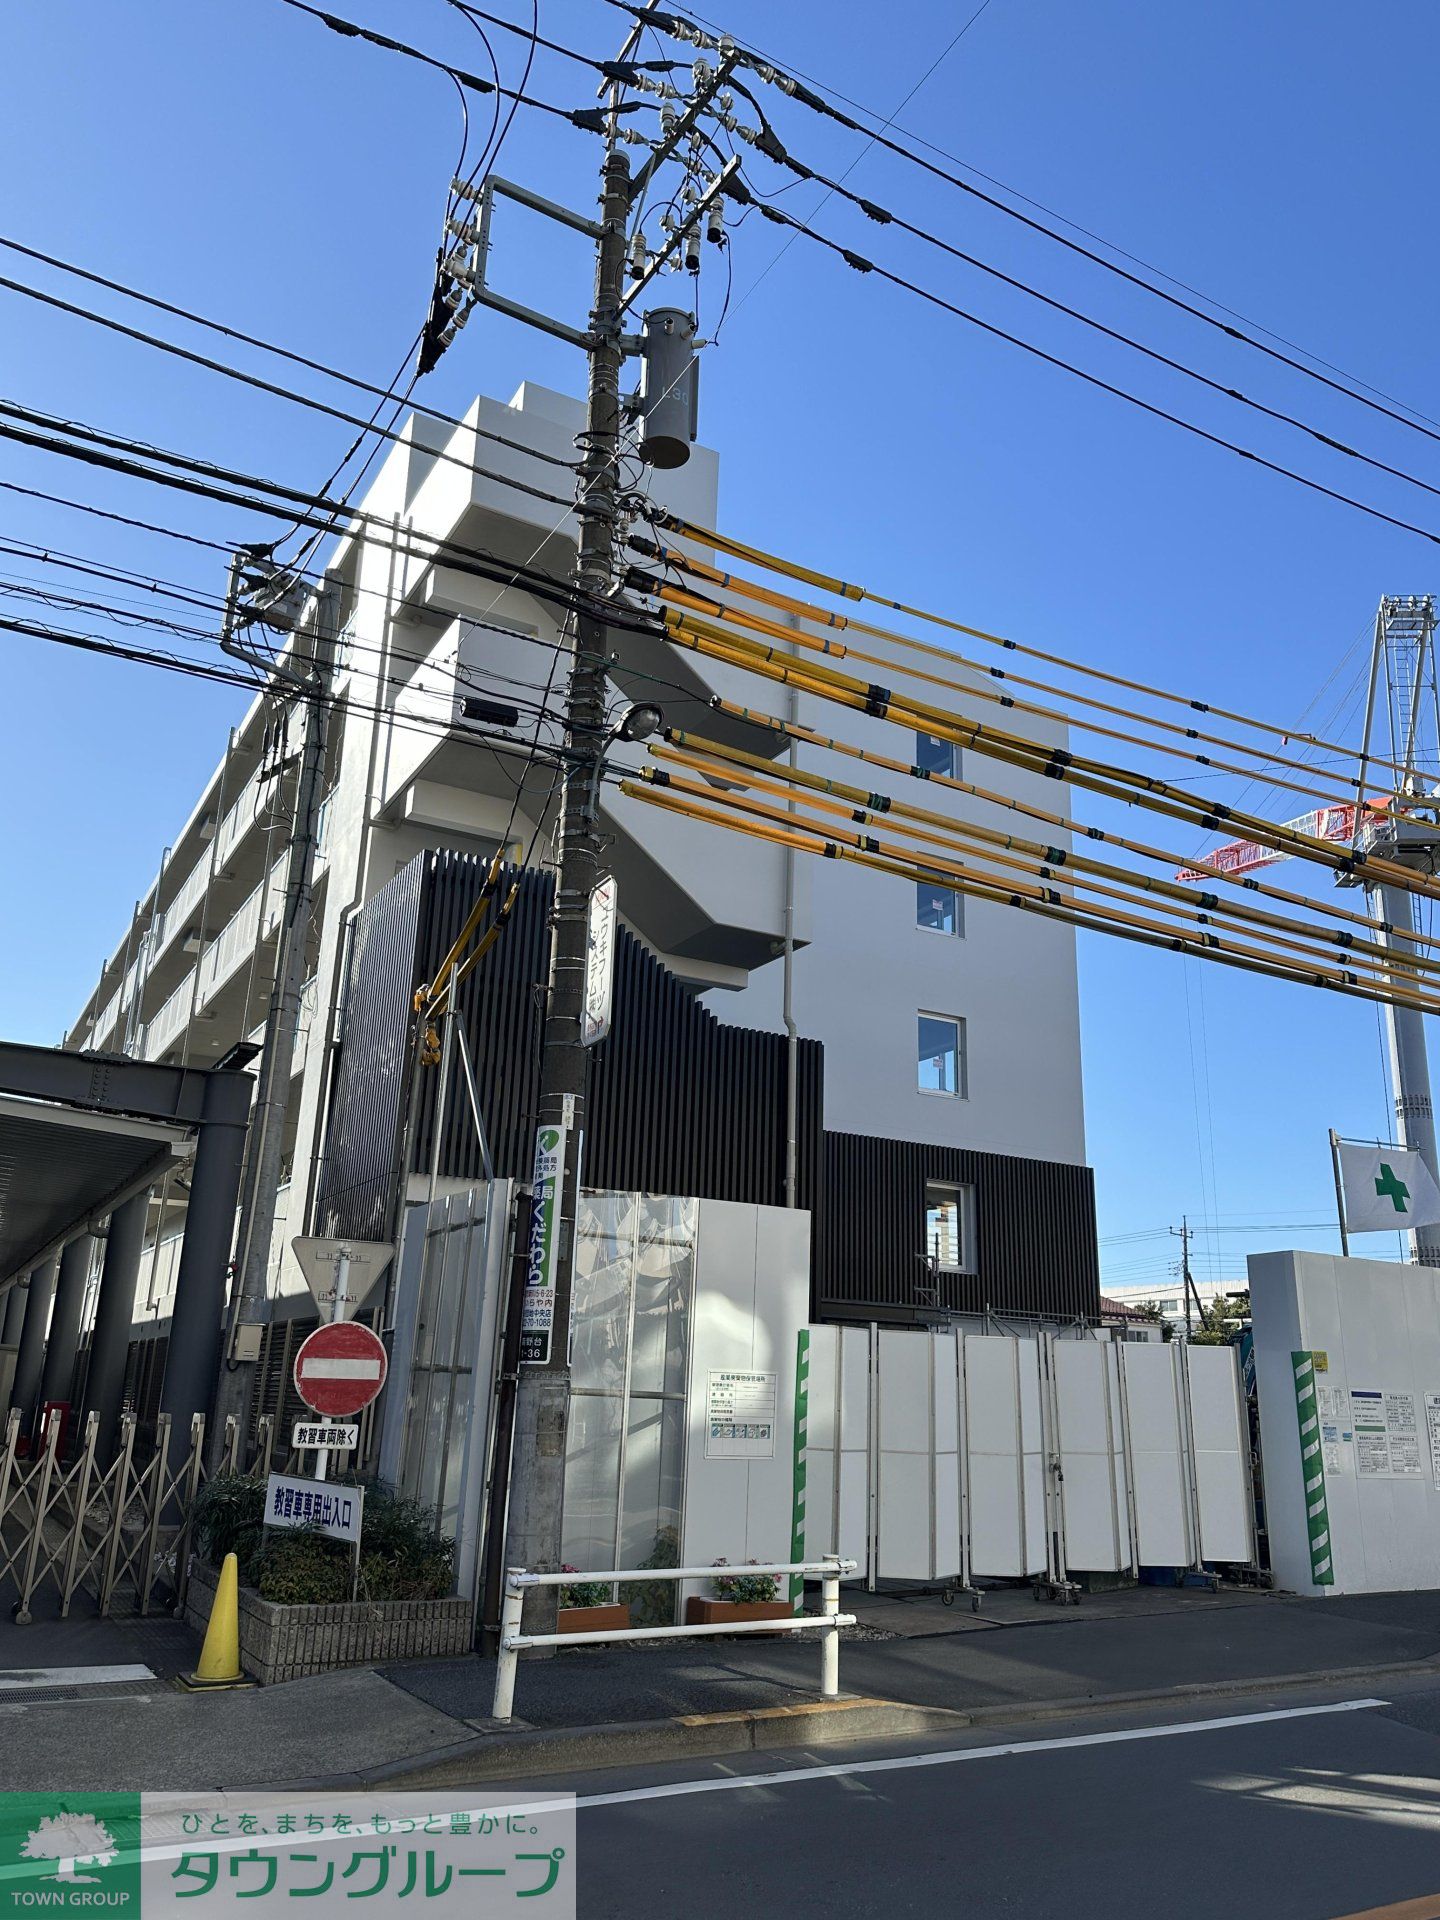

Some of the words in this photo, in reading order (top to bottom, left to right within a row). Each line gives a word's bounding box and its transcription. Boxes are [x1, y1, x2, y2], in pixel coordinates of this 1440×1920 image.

[529, 1200, 547, 1285] くだわら
[297, 1426, 355, 1446] 教習車両除く
[273, 1485, 352, 1530] 教習車専用出入口
